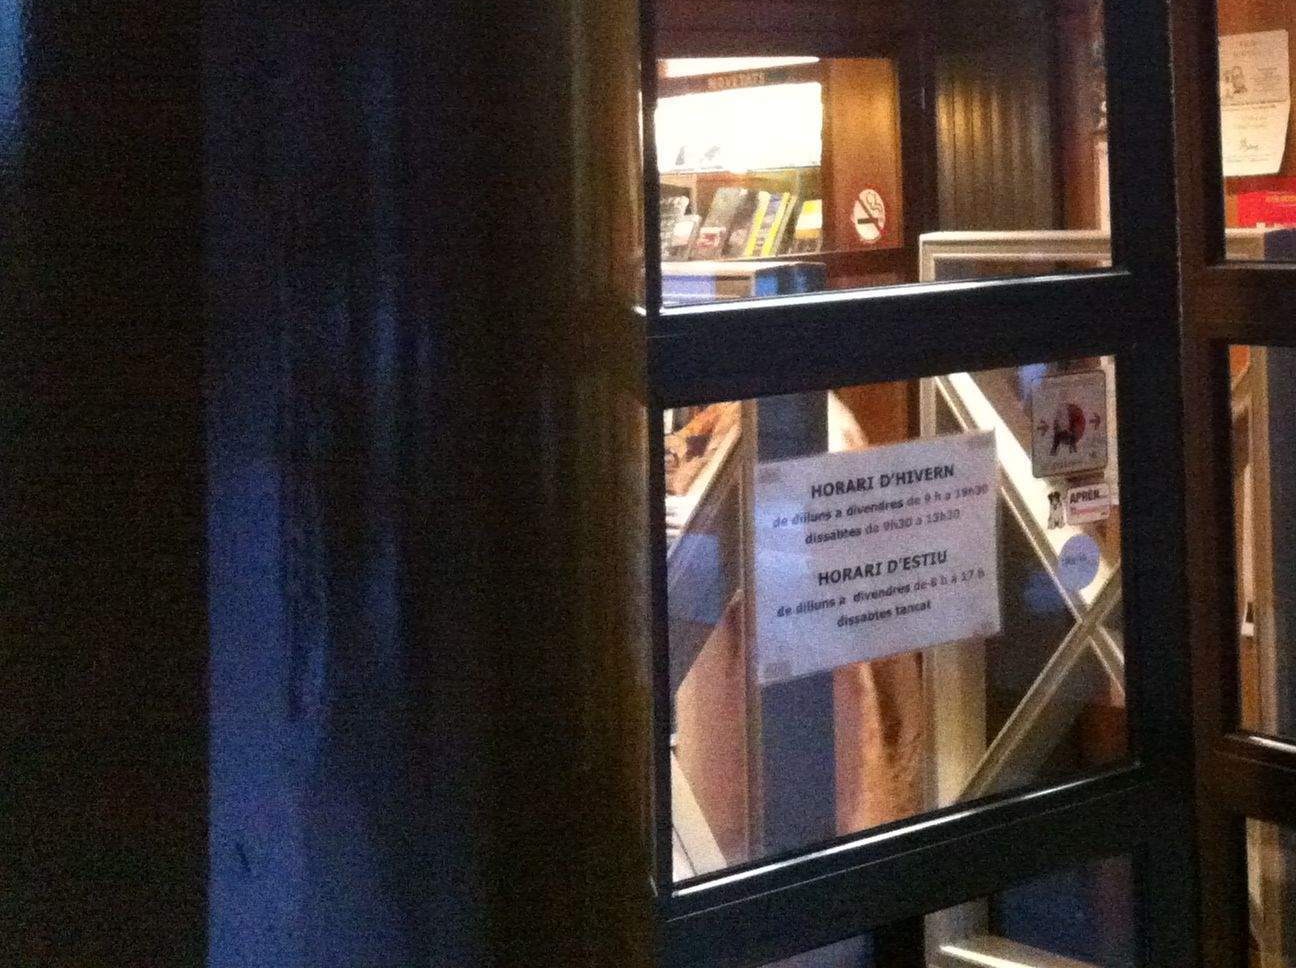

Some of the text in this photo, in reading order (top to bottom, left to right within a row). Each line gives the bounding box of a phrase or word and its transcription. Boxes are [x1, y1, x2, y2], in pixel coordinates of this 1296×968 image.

[811, 463, 955, 499] HORARI D'HIVERN
[773, 516, 788, 529] de
[846, 498, 904, 517] divendres
[906, 495, 921, 507] de
[865, 522, 880, 535] de
[818, 549, 948, 586] HORARI D'ESTIU
[776, 605, 792, 618] de
[795, 599, 836, 614] dilluns
[852, 584, 911, 604] divendres
[836, 599, 932, 628] dissabtes tancat
